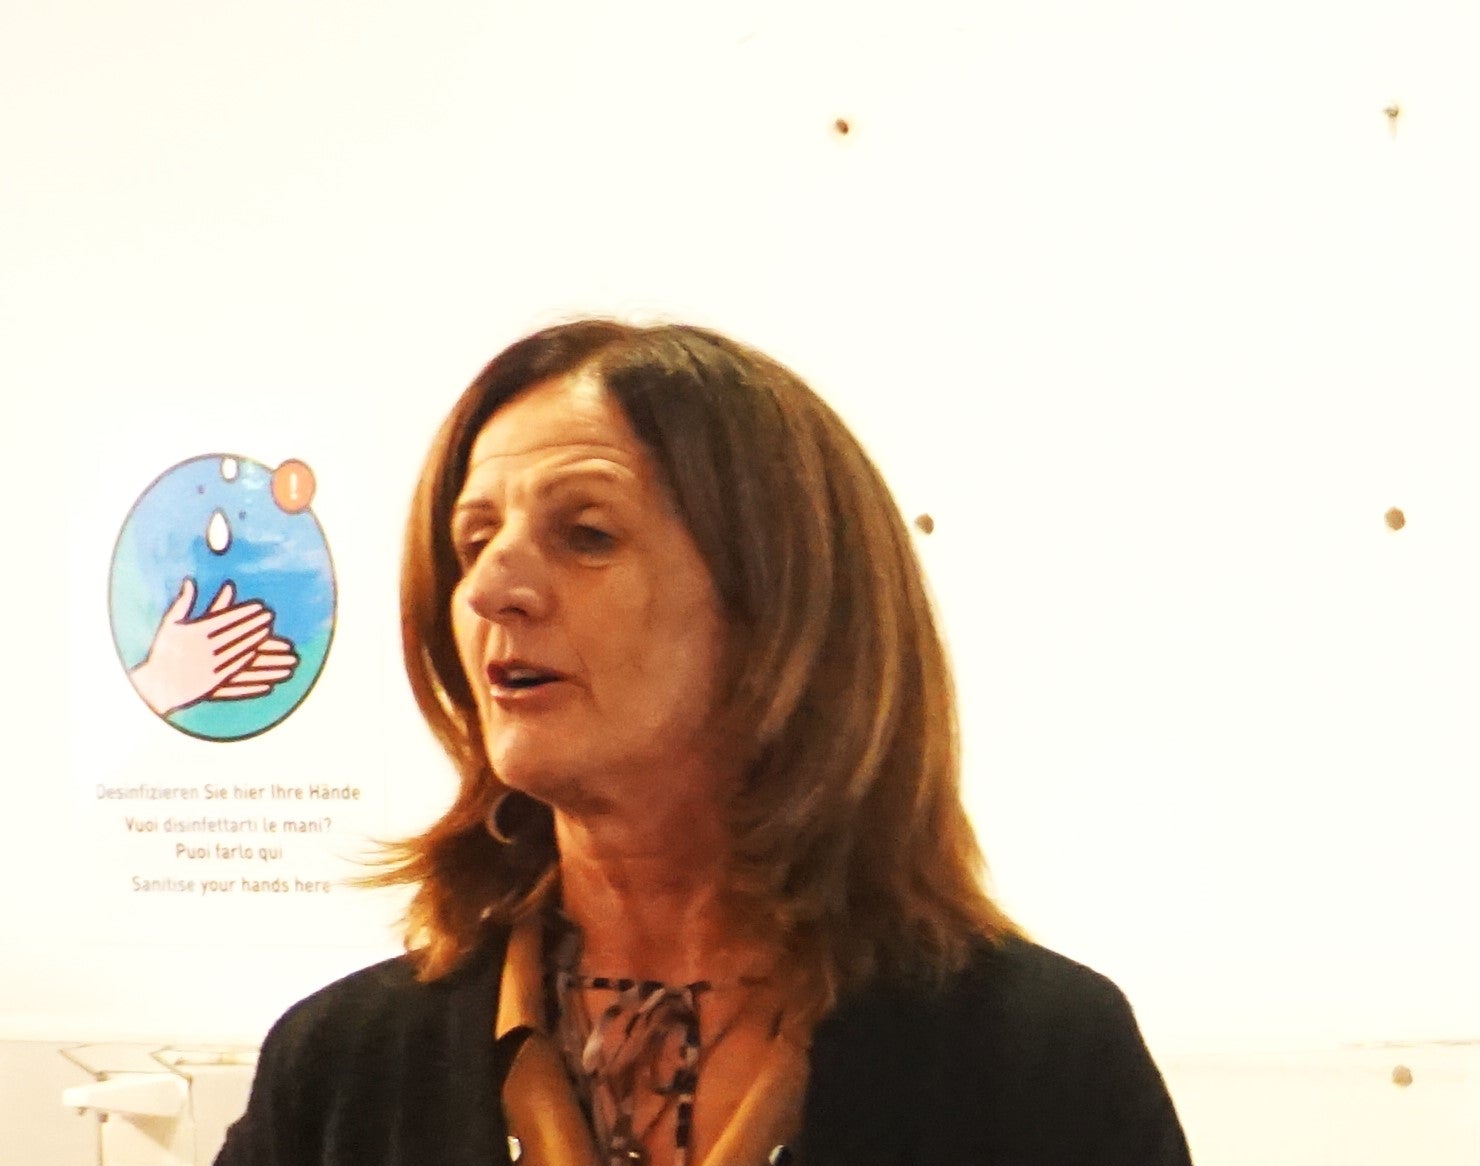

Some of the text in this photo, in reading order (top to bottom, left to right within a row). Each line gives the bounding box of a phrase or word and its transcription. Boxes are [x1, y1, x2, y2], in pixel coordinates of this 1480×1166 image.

[203, 784, 228, 800] Sie
[233, 784, 265, 800] hier
[271, 784, 303, 800] Ihre
[308, 783, 361, 800] Hände
[125, 817, 158, 833] Vuoi
[263, 817, 277, 833] le
[283, 817, 332, 833] mani?
[175, 843, 210, 859] Puoi
[259, 845, 283, 863] qui
[201, 879, 235, 896] your
[241, 876, 289, 893] hands
[295, 876, 331, 893] here
